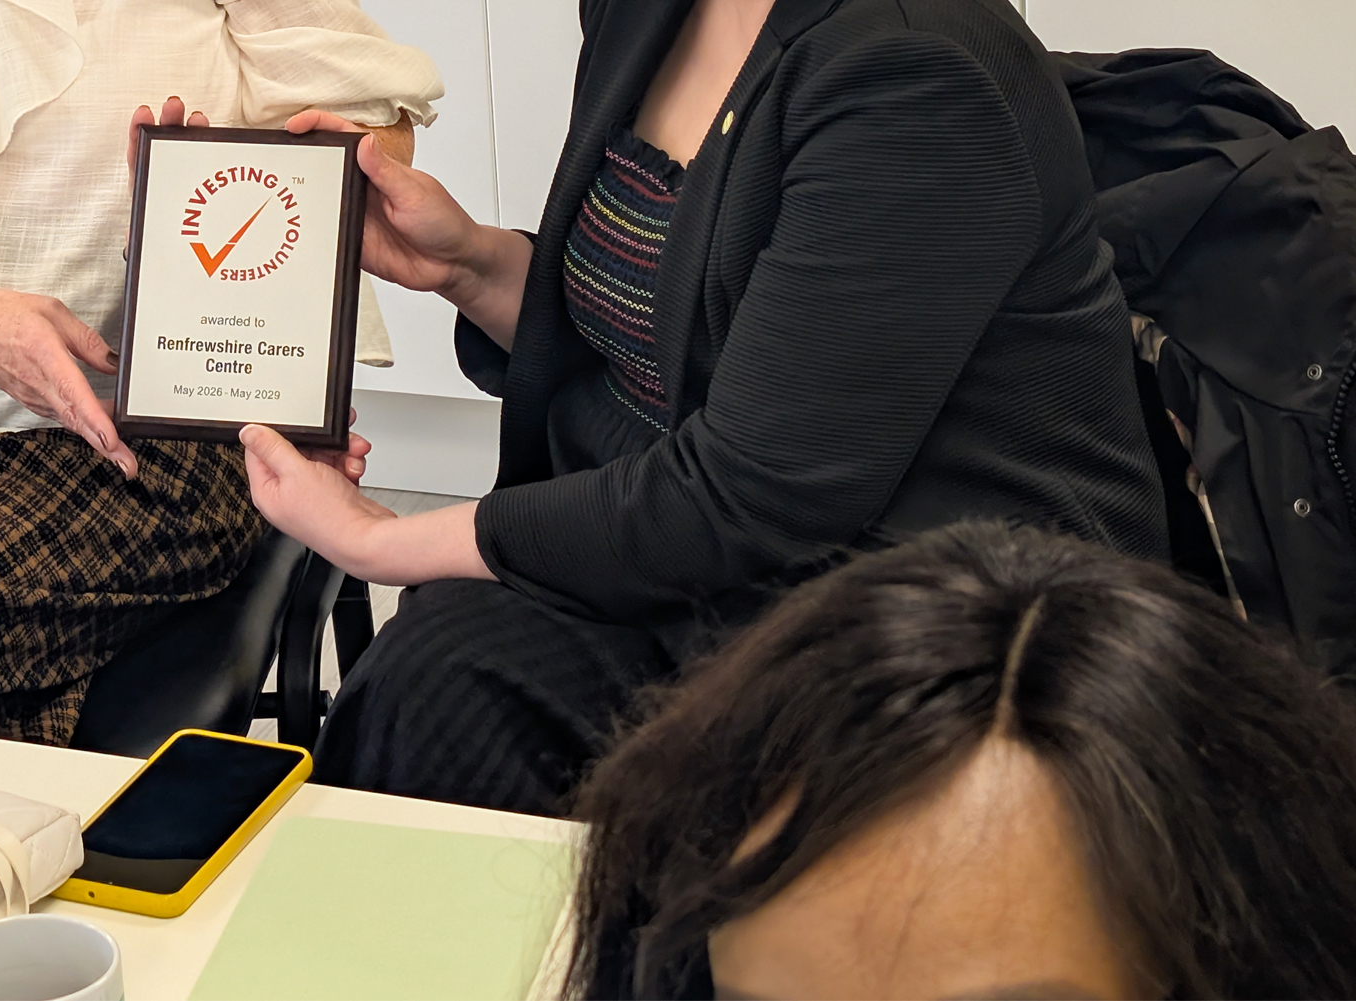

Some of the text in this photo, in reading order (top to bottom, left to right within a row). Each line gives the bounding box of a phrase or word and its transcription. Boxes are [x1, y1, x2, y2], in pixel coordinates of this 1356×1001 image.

[181, 166, 301, 281] INVESTING IN VOLUNTEERS
[200, 315, 266, 328] awarded to
[157, 336, 305, 358] Renfrewshire Carers
[205, 358, 253, 375] Centre
[173, 384, 195, 397] May
[196, 386, 223, 397] 2026
[230, 388, 252, 400] May
[254, 389, 281, 400] 2029
